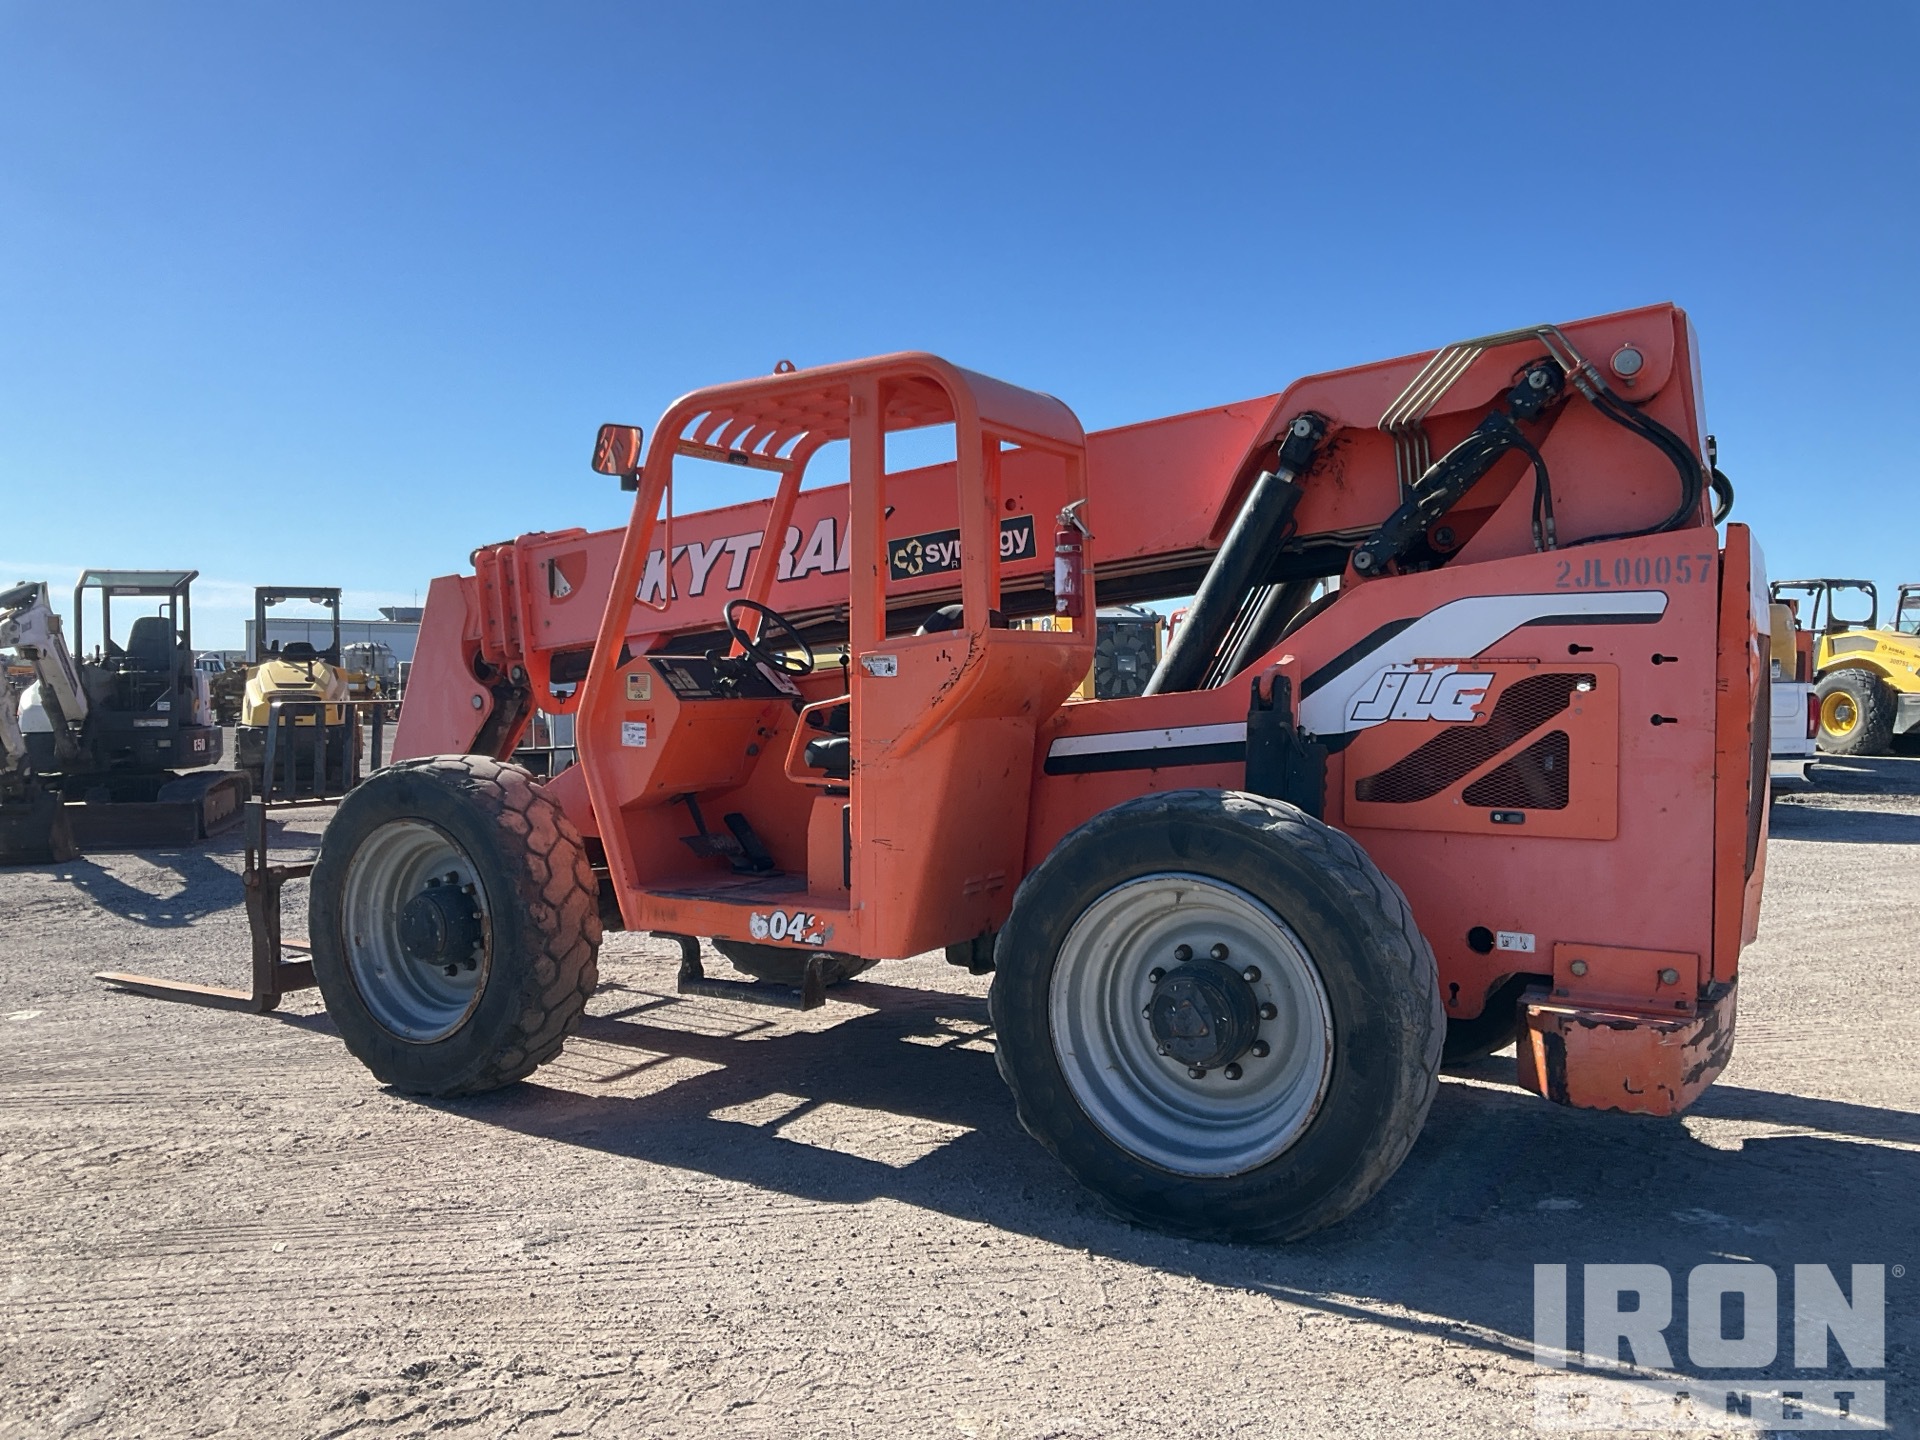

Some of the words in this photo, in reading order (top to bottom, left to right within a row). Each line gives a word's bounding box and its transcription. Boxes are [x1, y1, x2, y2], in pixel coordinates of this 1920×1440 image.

[607, 506, 895, 603] KYTRA
[925, 528, 1029, 567] sygy
[1556, 554, 1713, 588] 2JL00057
[1350, 671, 1497, 722] JLG
